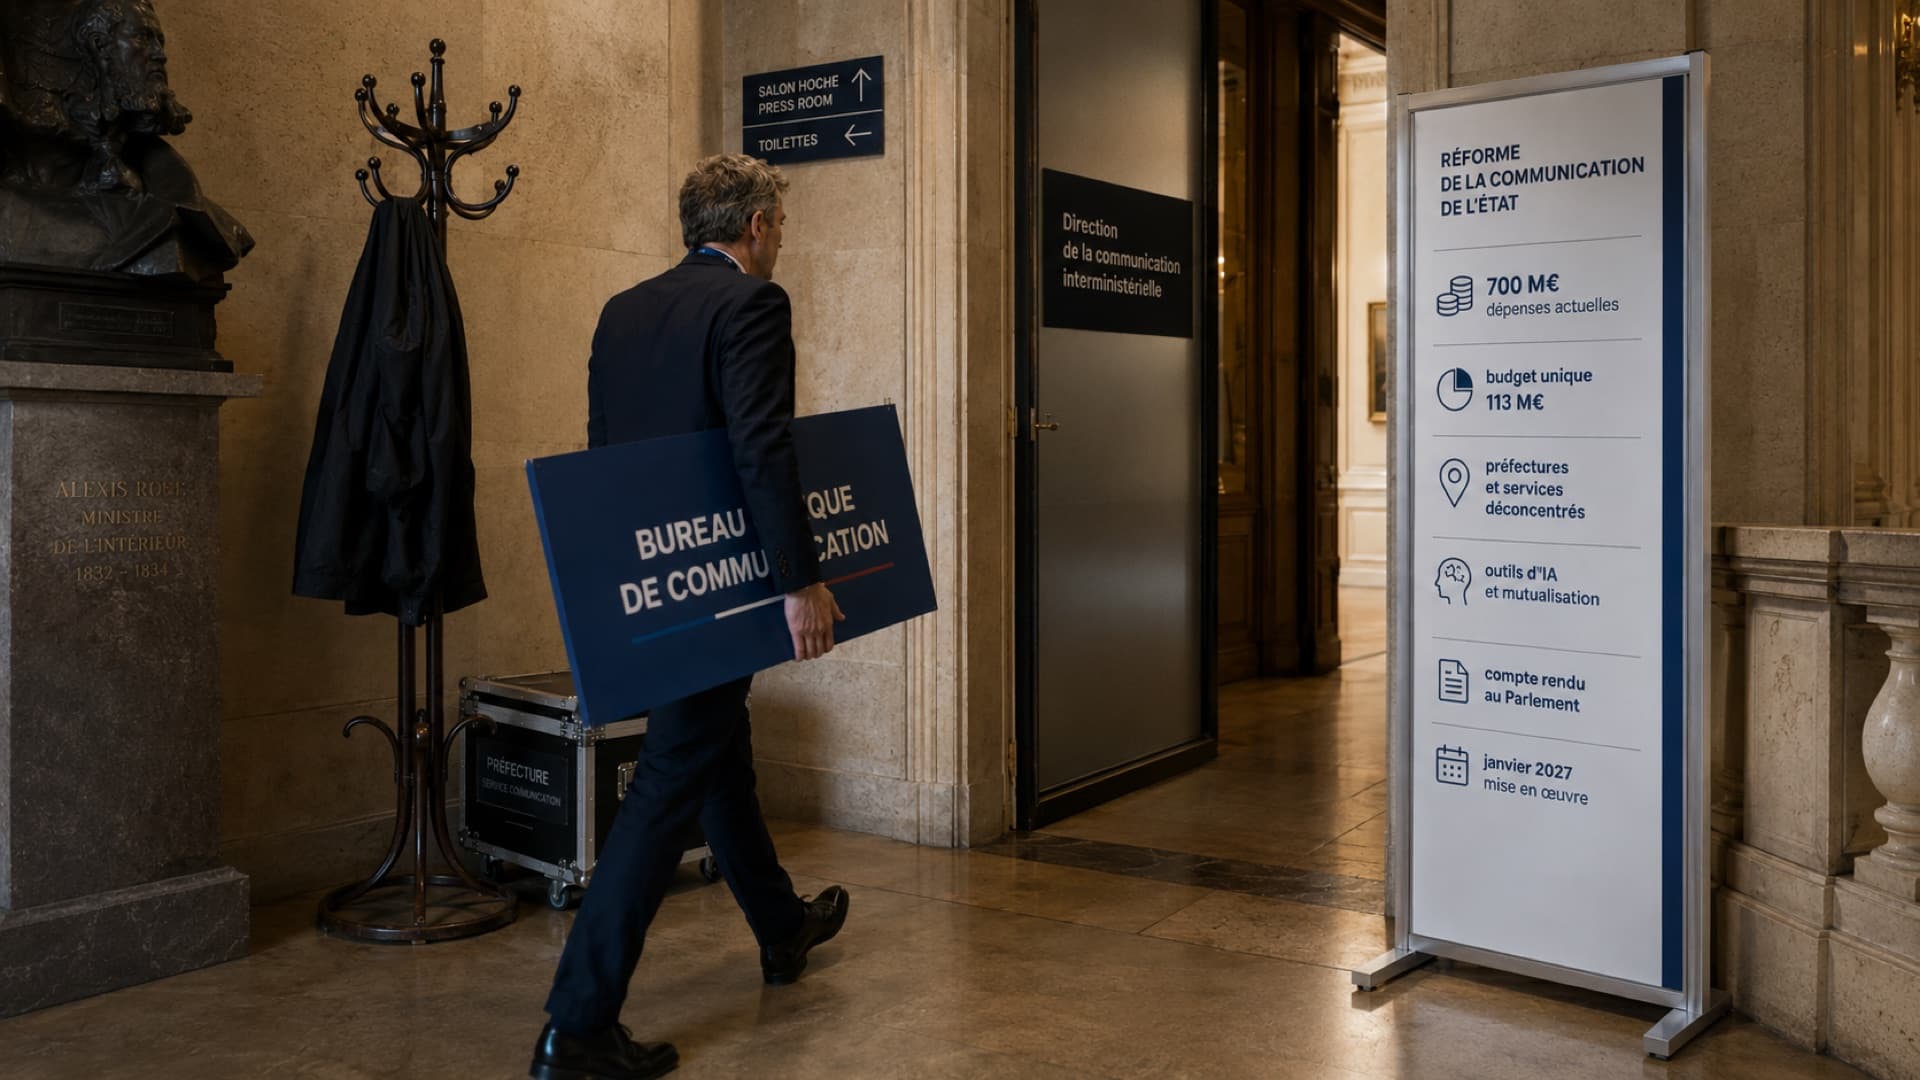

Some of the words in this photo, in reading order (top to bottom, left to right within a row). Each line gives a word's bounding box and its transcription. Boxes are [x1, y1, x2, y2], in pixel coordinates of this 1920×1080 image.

[758, 80, 796, 98] SALON
[798, 74, 839, 92] HOCHE
[758, 99, 795, 115] PRESS
[797, 93, 833, 110] ROOM
[758, 133, 818, 152] TOILETTES
[1441, 144, 1521, 168] RÉFORME
[1441, 175, 1462, 192] DE
[1465, 173, 1487, 190] LA
[1490, 156, 1645, 187] COMMUNICATION
[1441, 200, 1462, 217] DE
[1466, 194, 1519, 214] L'ÉTAT
[1063, 212, 1118, 239] Direction
[1063, 240, 1079, 259] de
[1082, 242, 1093, 262] la
[1095, 249, 1181, 274] communication
[1063, 268, 1162, 298] interministérielle
[1486, 275, 1522, 296] 700
[1527, 273, 1560, 293] M€
[1486, 302, 1551, 319] dépenses
[1555, 297, 1620, 314] actuelles
[1486, 369, 1537, 387] budget
[1540, 367, 1593, 386] unique
[1486, 394, 1512, 410] 113
[1516, 393, 1544, 410] M€
[1486, 459, 1569, 476] préfectures
[55, 480, 128, 498] ALEXIS
[1485, 481, 1500, 494] et
[1503, 480, 1563, 497] services
[81, 510, 162, 526] MINISTRE
[1485, 500, 1586, 519] déconcentrés
[634, 508, 746, 560] BUREAU
[54, 538, 78, 555] DE
[76, 566, 113, 582] 1832
[135, 562, 169, 578] 1834
[1485, 564, 1524, 580] outils
[619, 577, 663, 616] DE
[1485, 585, 1499, 599] et
[1502, 586, 1600, 606] mutualisation
[1484, 667, 1539, 686] compte
[1541, 674, 1586, 691] rendu
[1484, 690, 1501, 703] au
[1505, 690, 1581, 713] Parlement
[487, 756, 550, 786] PRÉFECTURE
[1483, 753, 1532, 774] janvier
[1535, 762, 1573, 780] 2027
[1483, 776, 1516, 794] mise
[1519, 784, 1537, 798] en
[1541, 788, 1589, 806] œuvre
